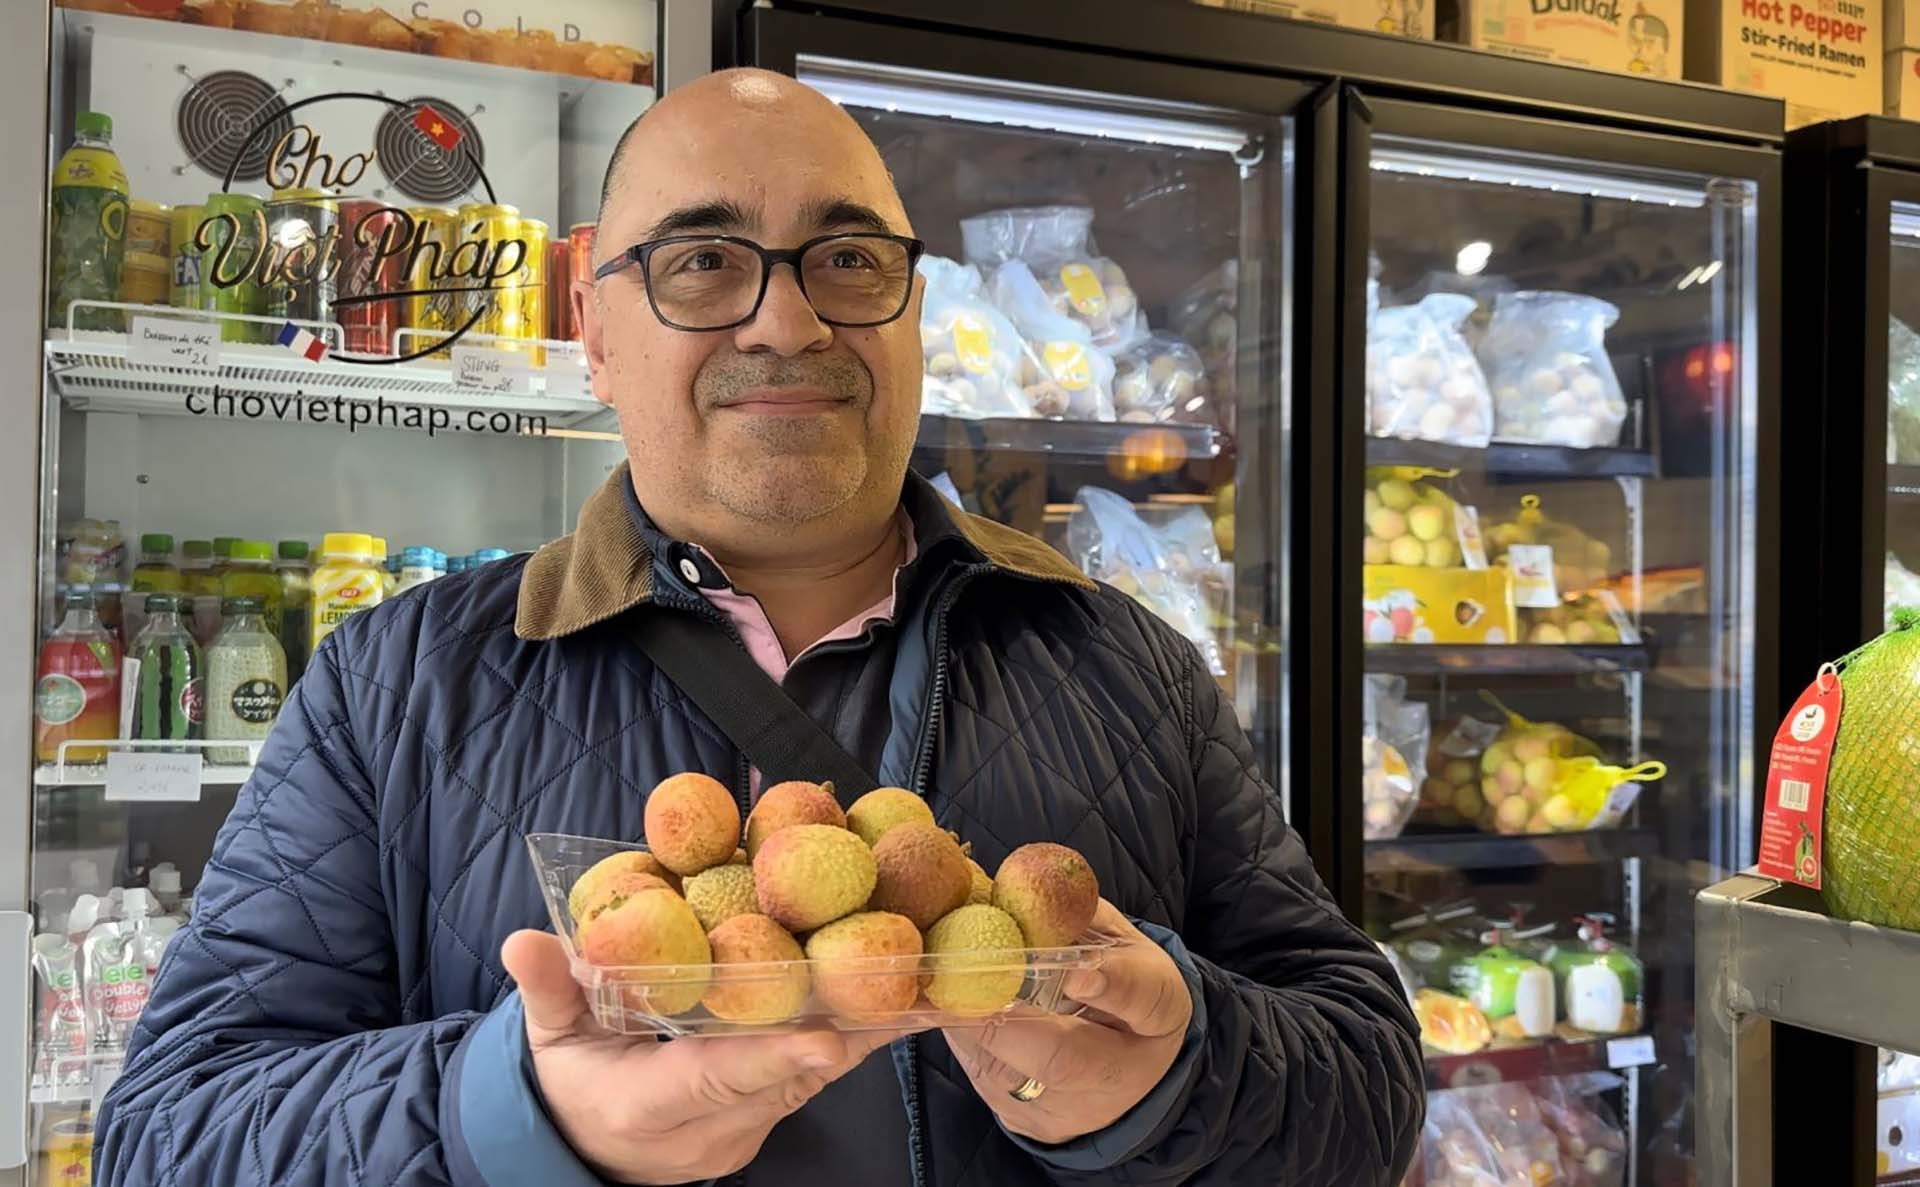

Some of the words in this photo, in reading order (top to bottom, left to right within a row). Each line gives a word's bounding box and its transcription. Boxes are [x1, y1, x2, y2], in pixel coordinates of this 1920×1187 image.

[411, 1, 581, 42] COLD
[1741, 0, 1784, 25] Hot
[1789, 4, 1867, 43] Pepper
[1741, 27, 1815, 57] Stir-Fried
[1818, 44, 1866, 68] Ramen
[354, 206, 528, 289] Pháp
[185, 385, 548, 437] chovietphap.com
